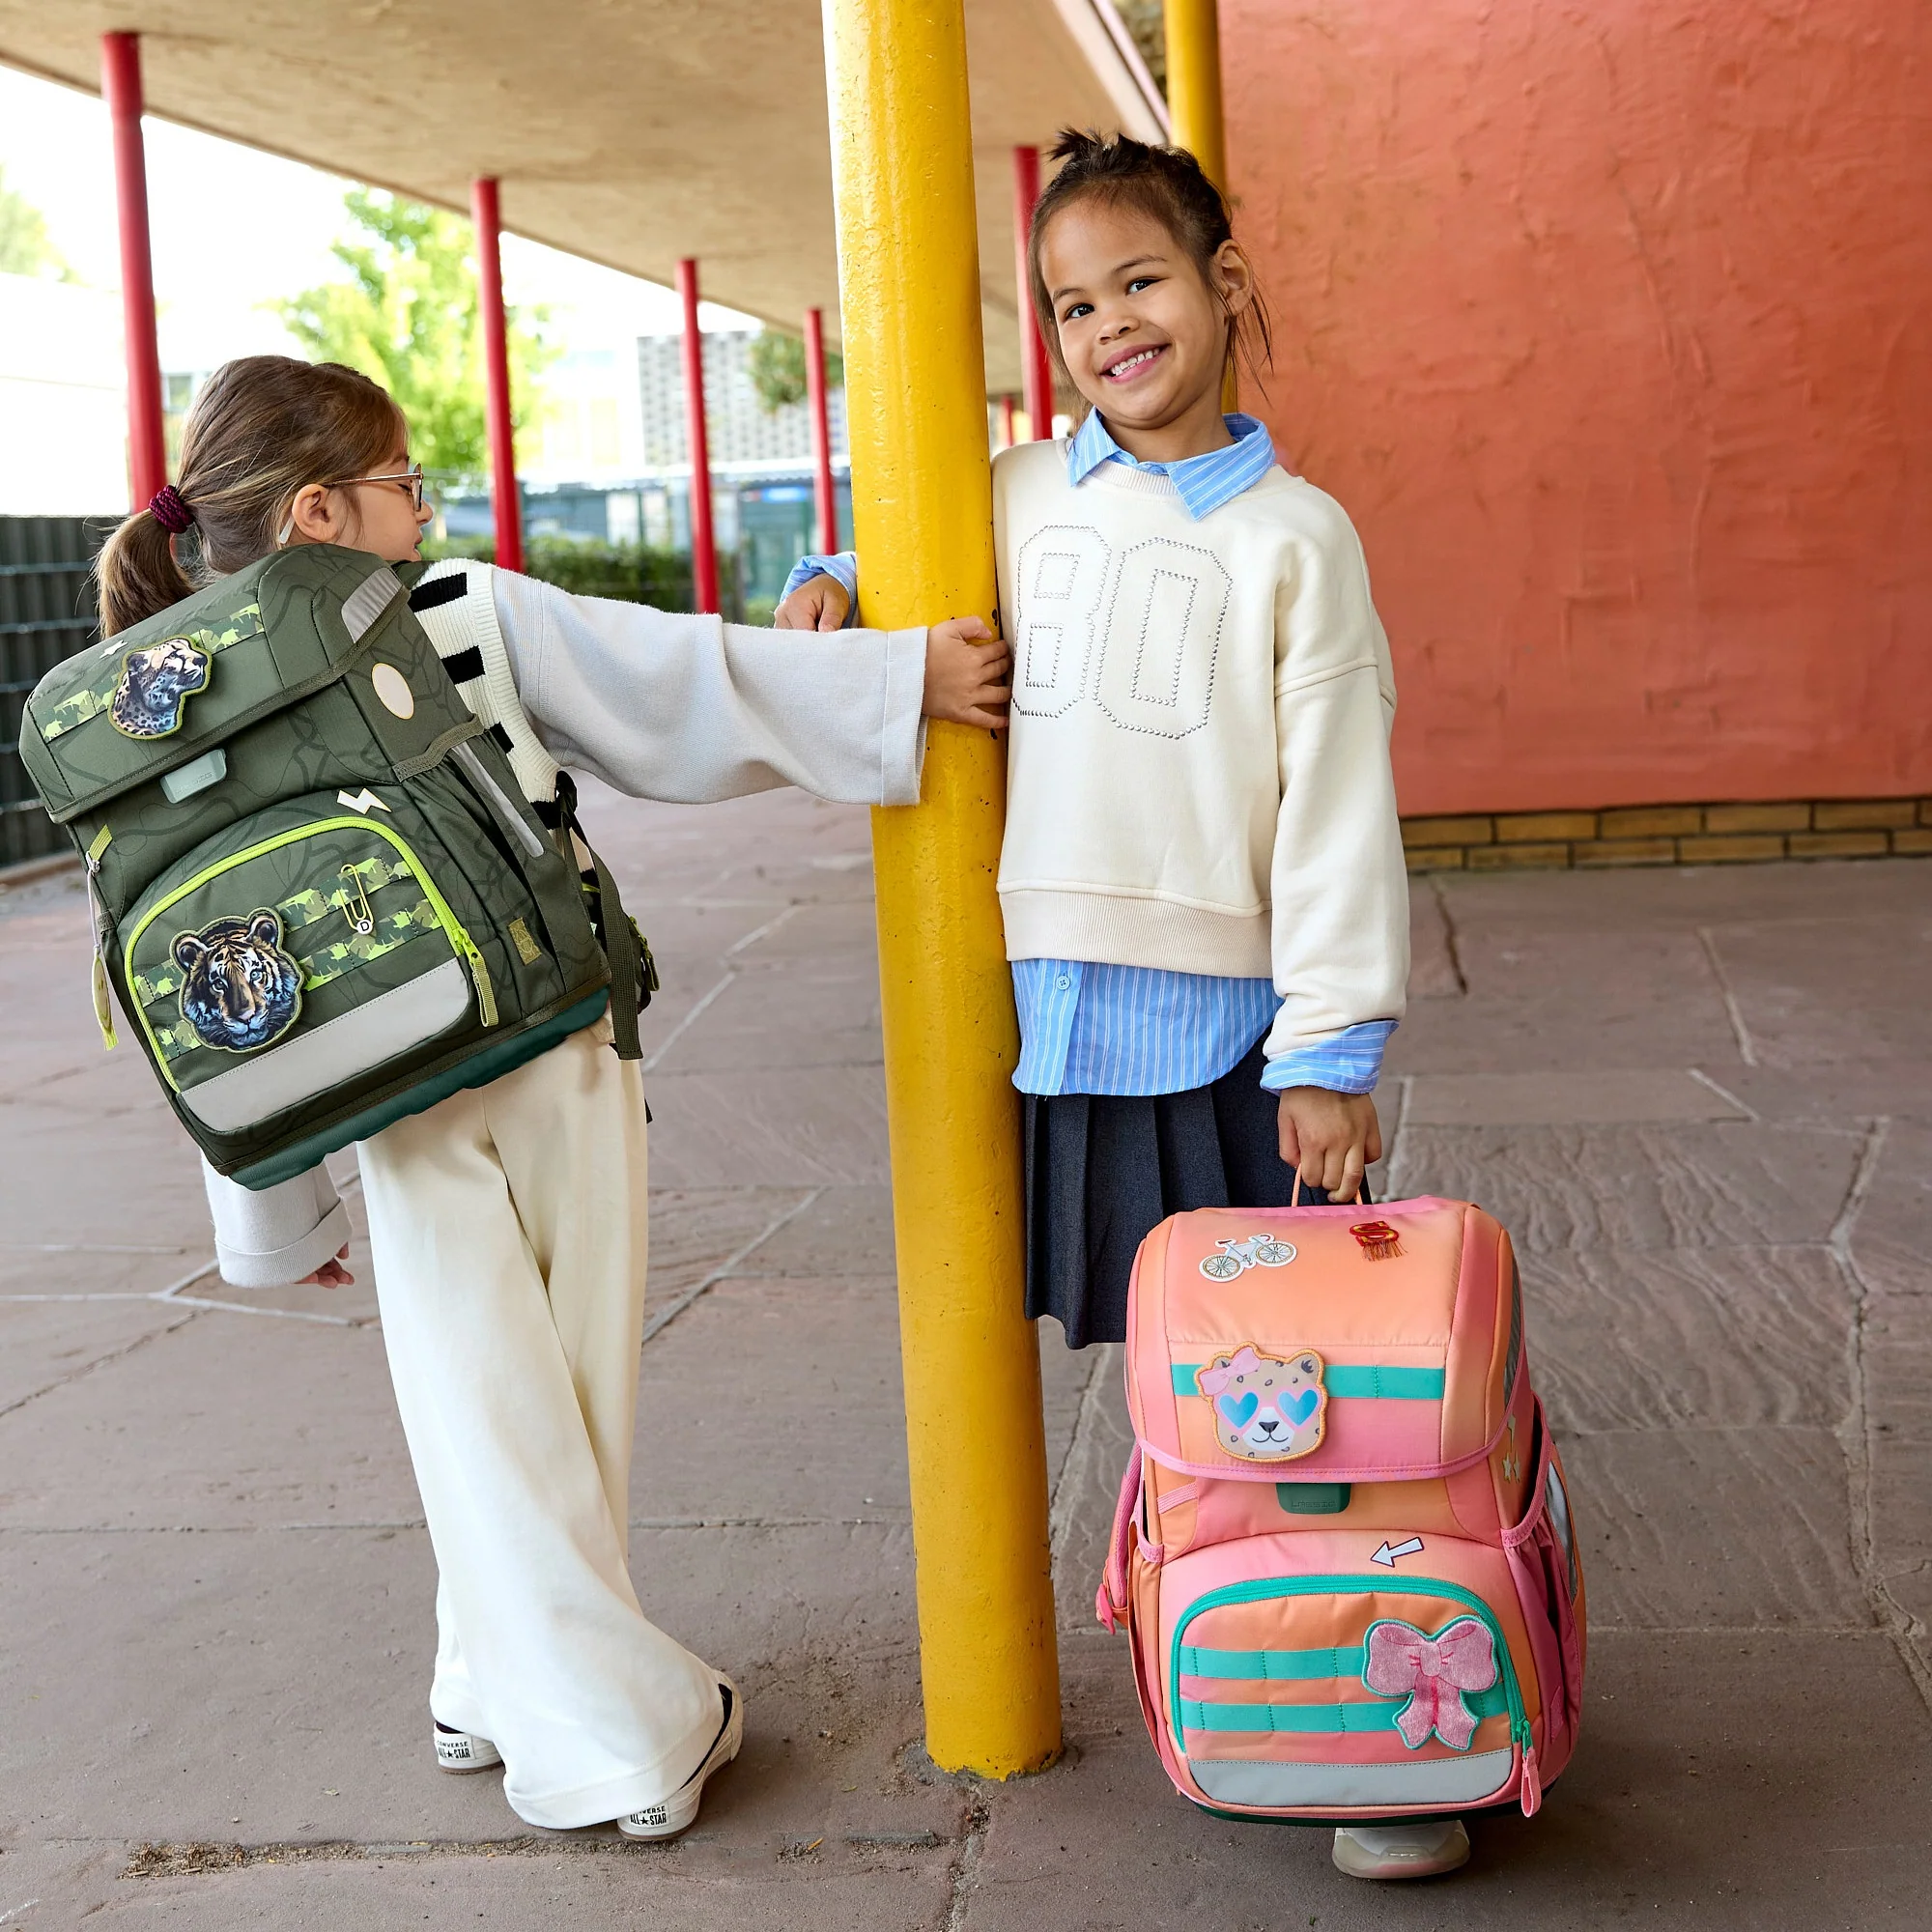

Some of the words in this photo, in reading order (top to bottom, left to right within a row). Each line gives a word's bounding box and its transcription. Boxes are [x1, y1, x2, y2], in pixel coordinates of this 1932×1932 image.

[1012, 525, 1234, 741] 80
[360, 921, 370, 932] D
[453, 1747, 470, 1759] STAR
[649, 1812, 667, 1826] STAR
